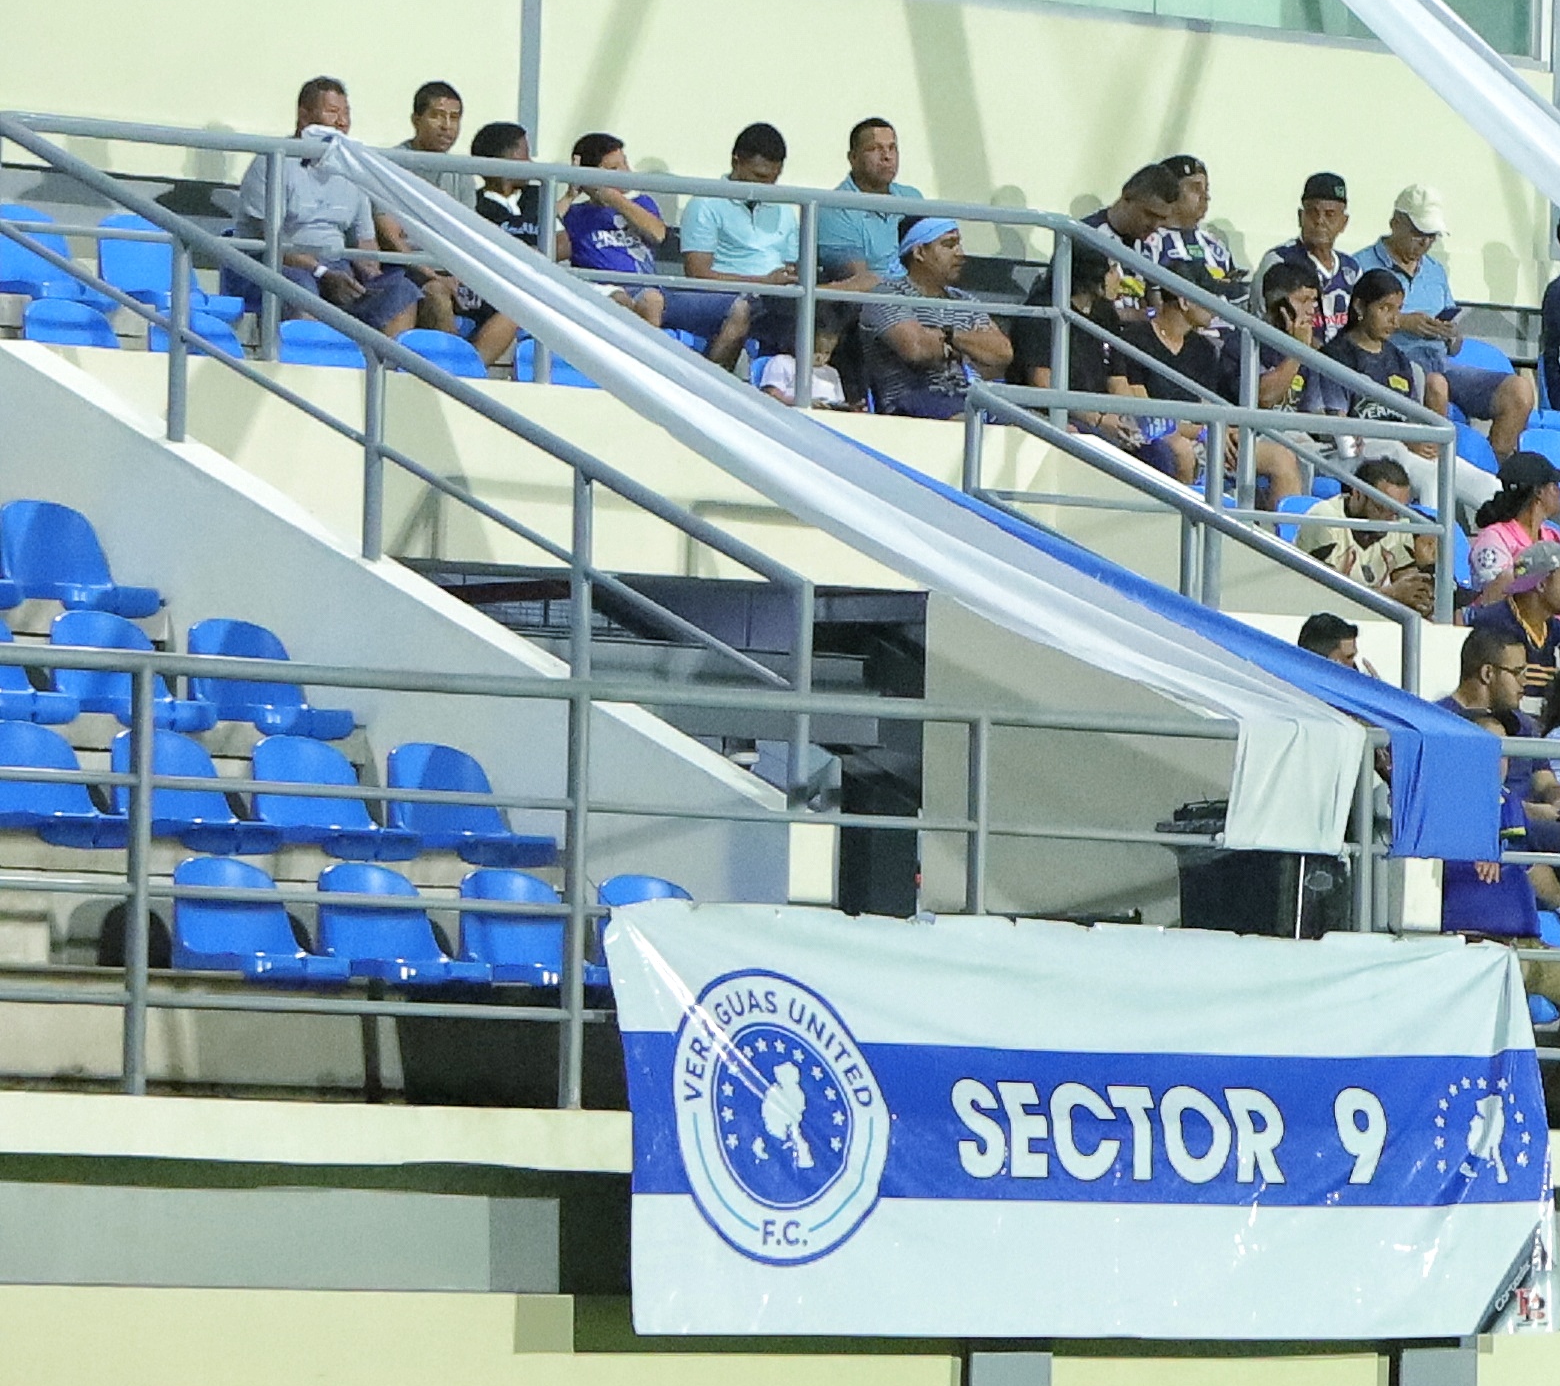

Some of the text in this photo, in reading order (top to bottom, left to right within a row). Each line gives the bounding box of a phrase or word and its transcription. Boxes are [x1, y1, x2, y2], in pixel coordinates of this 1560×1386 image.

[683, 990, 873, 1108] VERAGUAS UNITED
[951, 1078, 1387, 1187] SECTOR 9
[761, 1220, 808, 1246] F.C.
